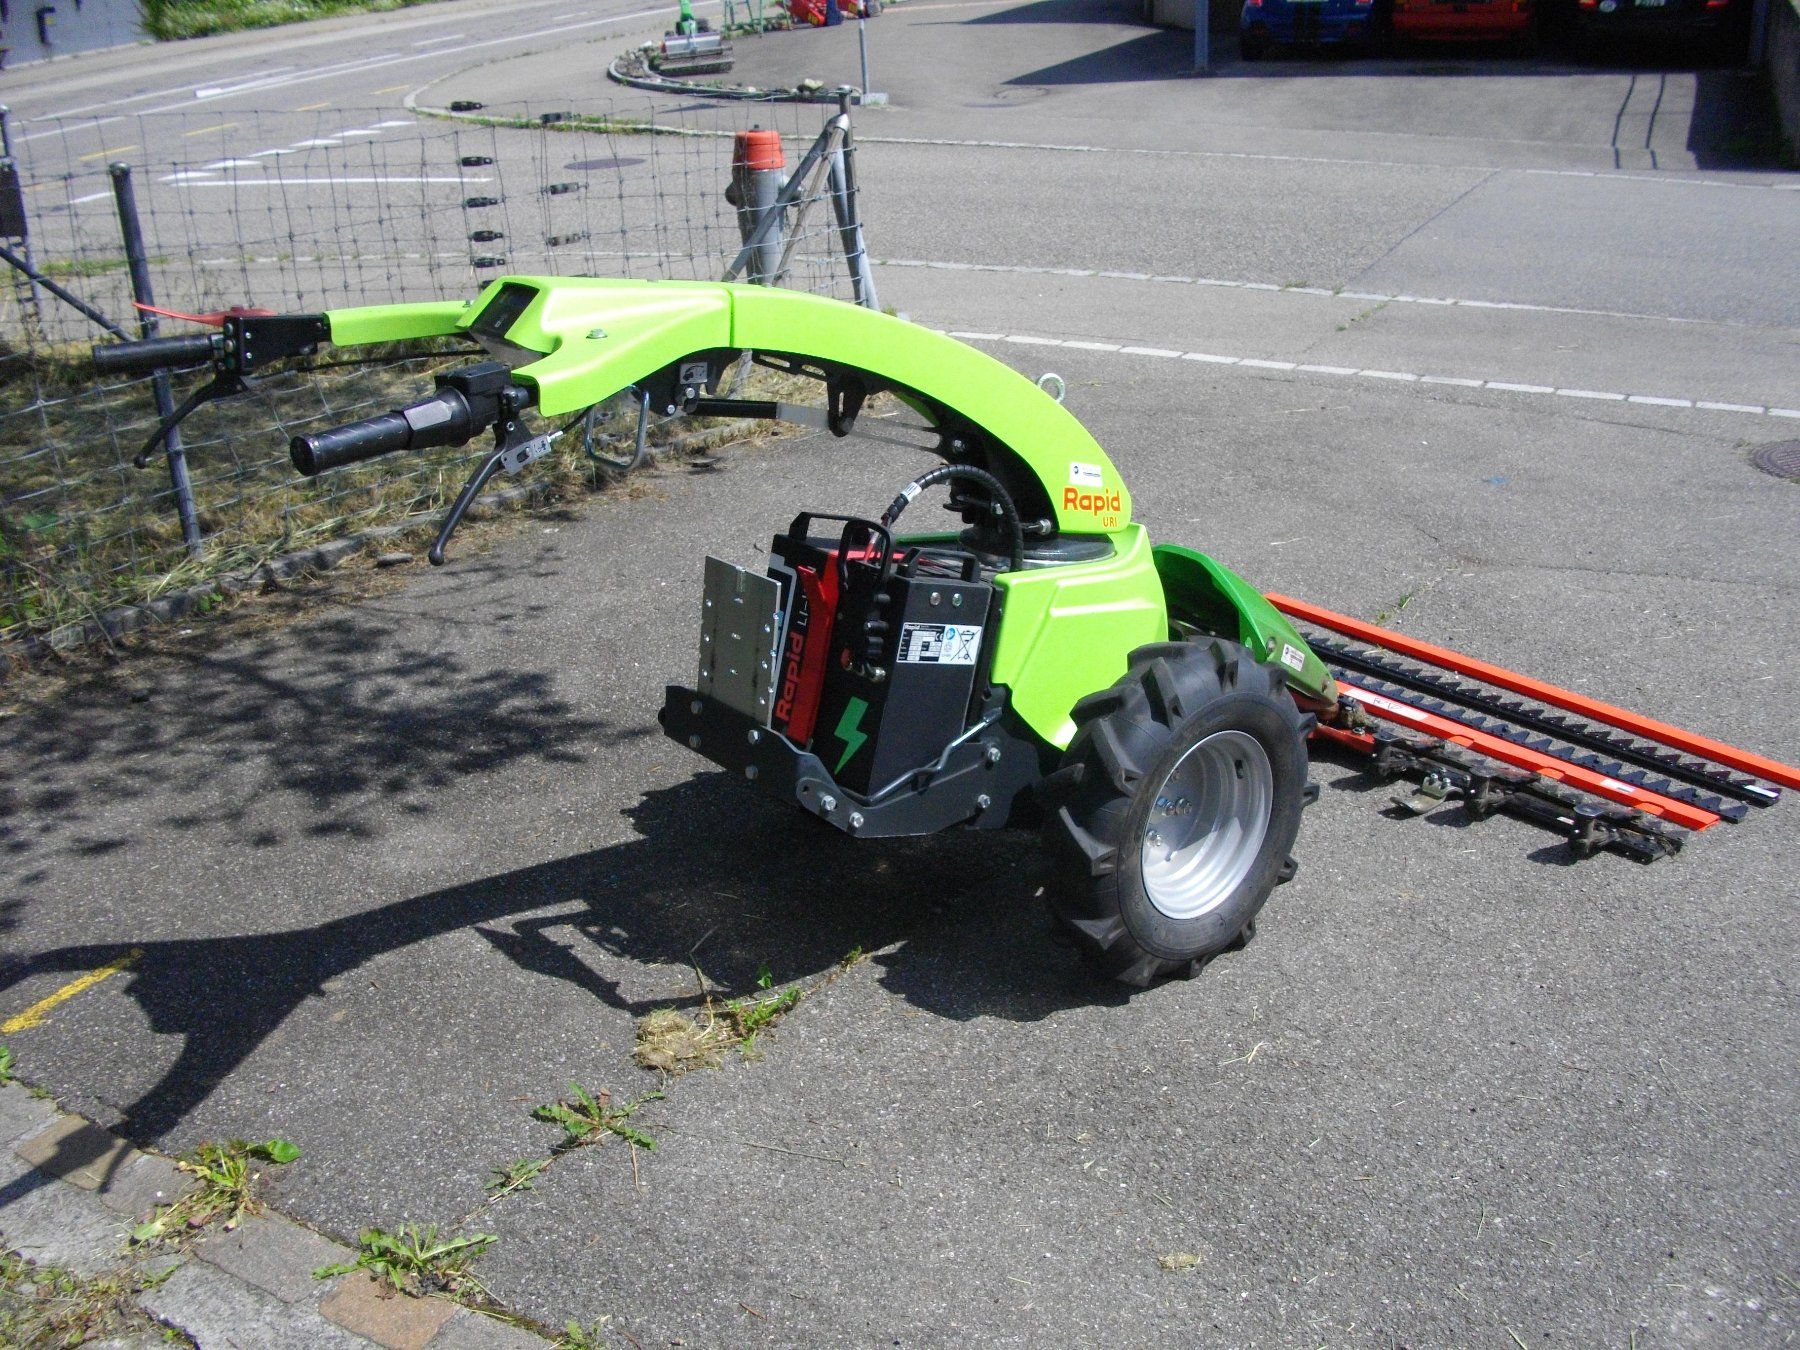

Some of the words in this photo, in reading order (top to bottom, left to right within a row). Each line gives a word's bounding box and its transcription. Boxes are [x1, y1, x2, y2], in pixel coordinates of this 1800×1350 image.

[1063, 487, 1121, 516] Rapid
[1102, 517, 1118, 527] URI
[775, 631, 803, 721] Rapid
